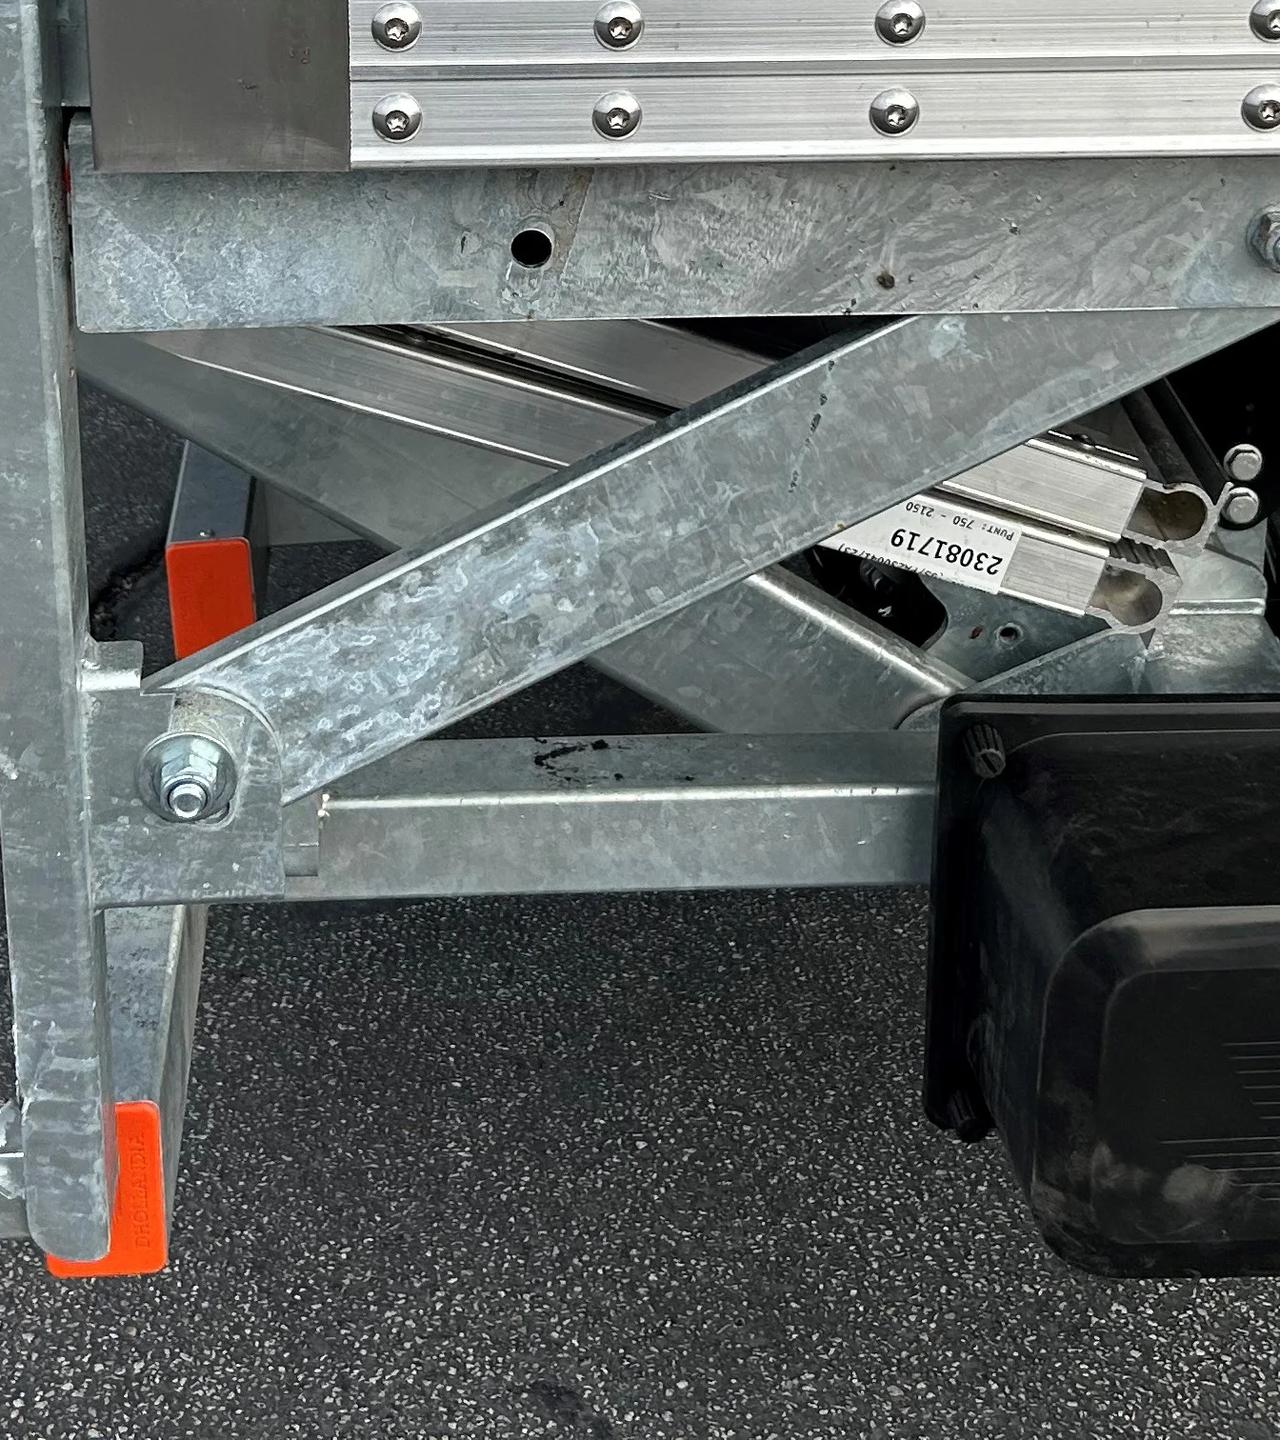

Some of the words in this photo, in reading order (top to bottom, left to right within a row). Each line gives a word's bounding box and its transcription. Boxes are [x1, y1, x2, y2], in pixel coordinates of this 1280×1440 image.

[906, 502, 934, 518] 2150
[952, 516, 975, 529] 750
[891, 528, 1002, 574] 23081719
[129, 1133, 150, 1248] DHOLLANDIA
